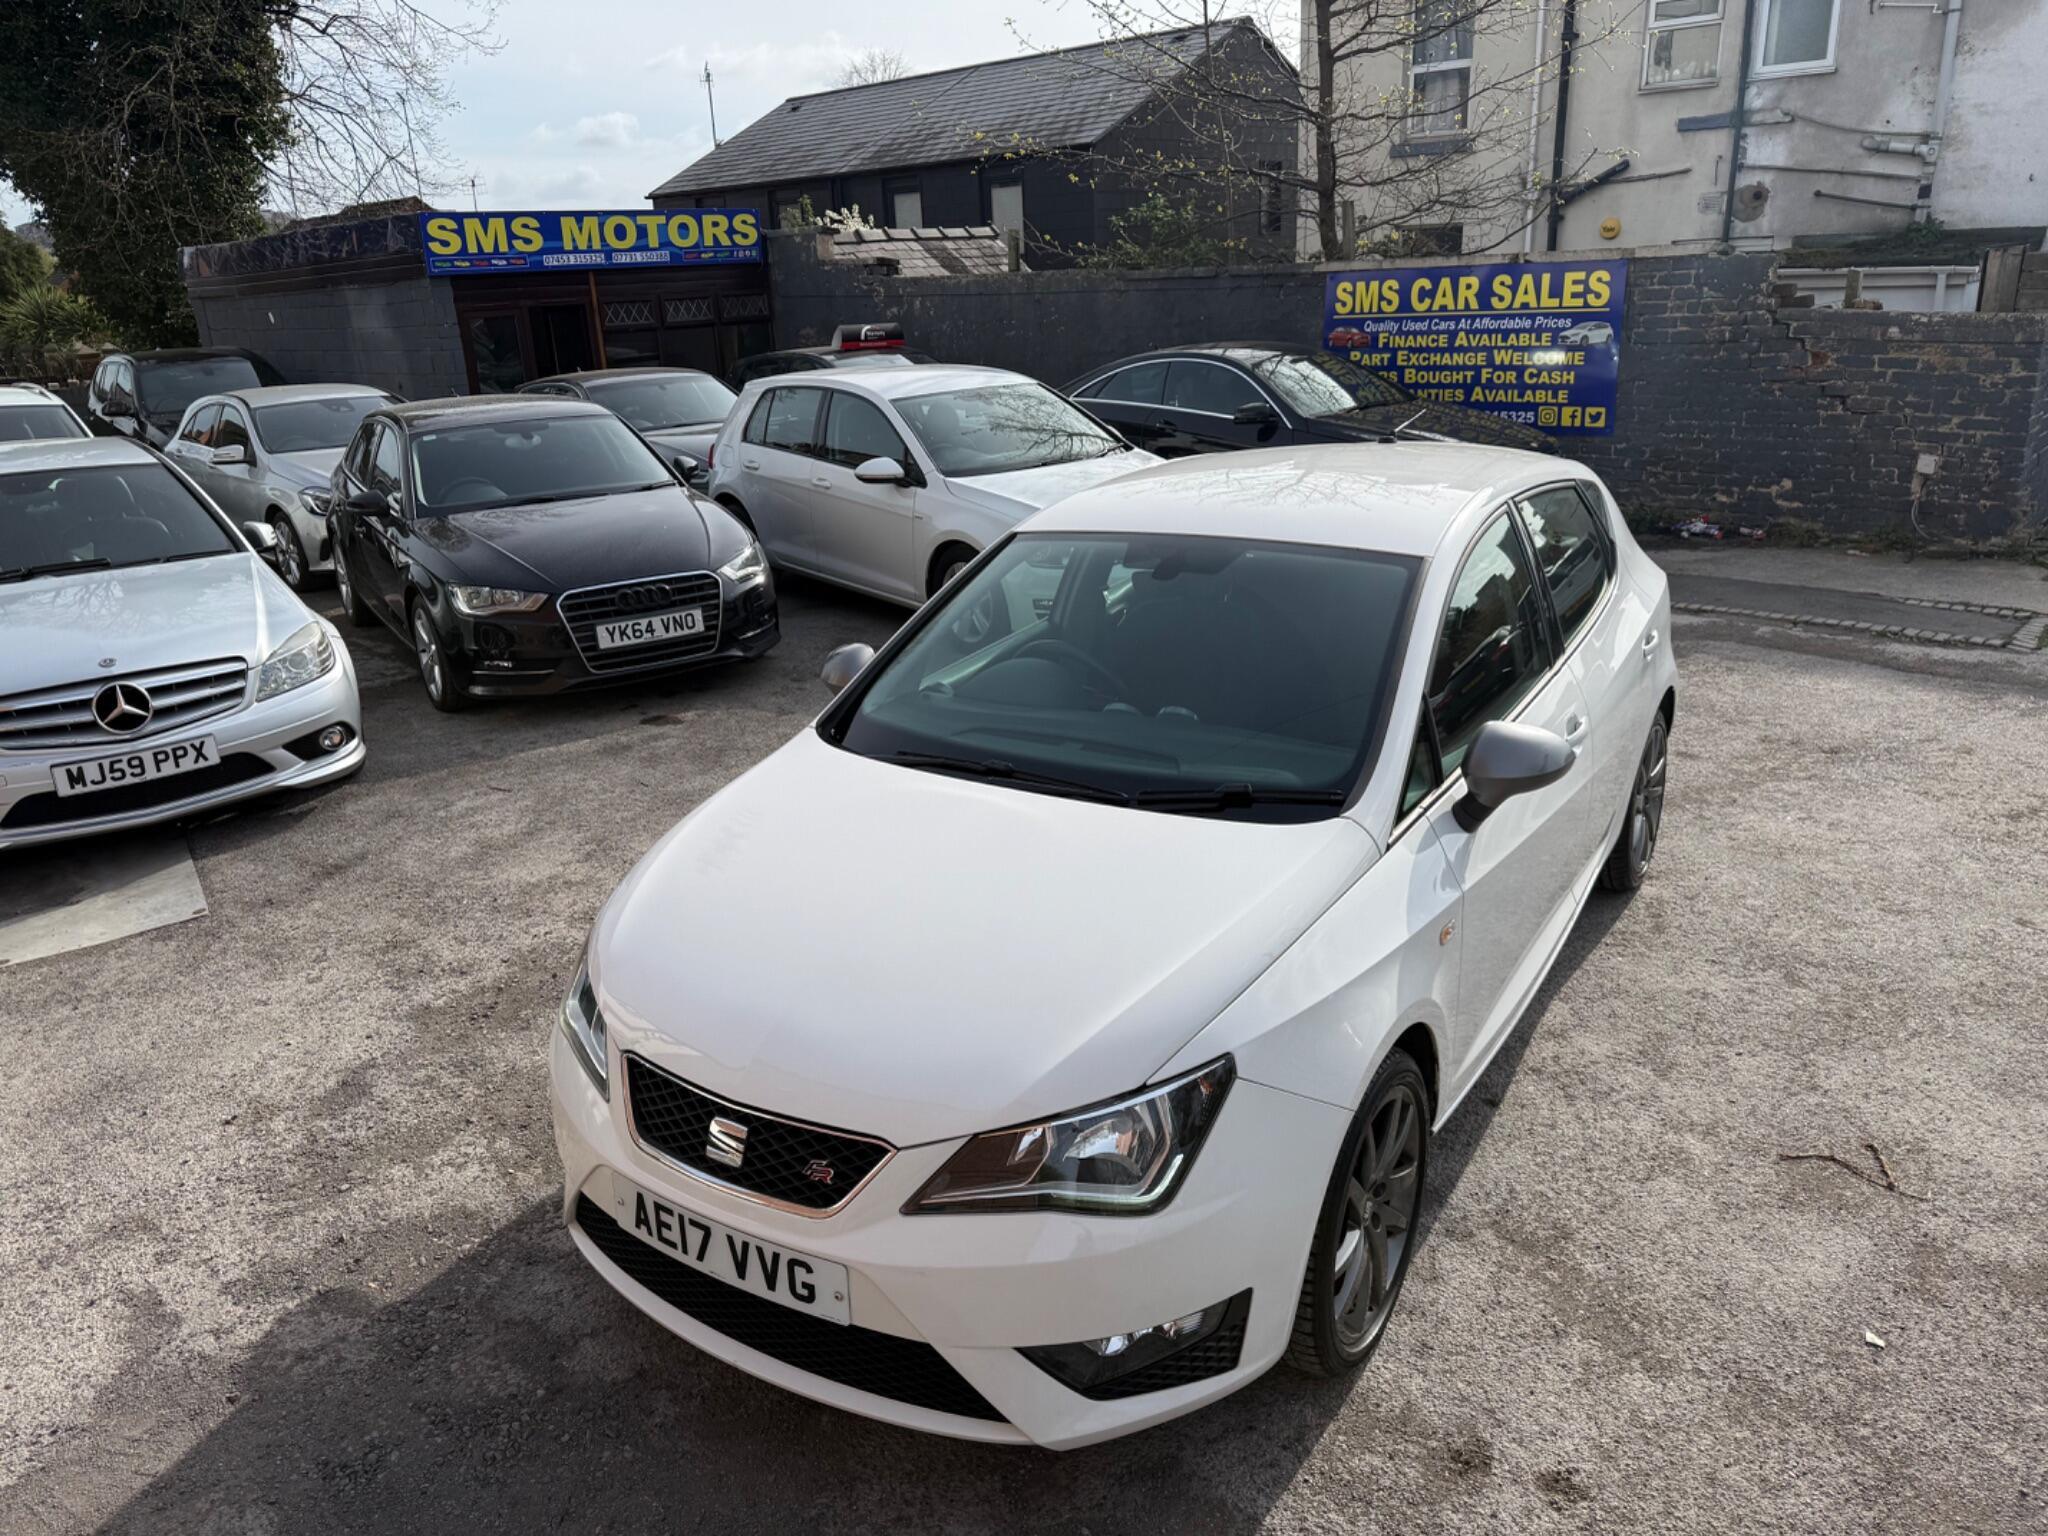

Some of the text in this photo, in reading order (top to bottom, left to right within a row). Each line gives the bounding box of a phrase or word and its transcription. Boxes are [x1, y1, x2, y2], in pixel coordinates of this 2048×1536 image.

[426, 213, 758, 254] SMS MOTORS
[1334, 270, 1612, 315] SMS CAR SALES
[1364, 315, 1573, 334] Quality Used Cars At Affordable Prices
[1377, 330, 1553, 349] FINANCE AVAILABLE
[1350, 349, 1586, 366] PART EXCHANGE WELCOME
[1403, 367, 1475, 384] BOUGHT
[1480, 367, 1517, 384] FOR
[1523, 367, 1576, 384] CASH
[1470, 386, 1569, 404] AVAILABLE
[604, 612, 697, 643] YK64 VNO
[65, 740, 208, 789] MJ59 PPX
[634, 1191, 817, 1305] AE17 VVG
